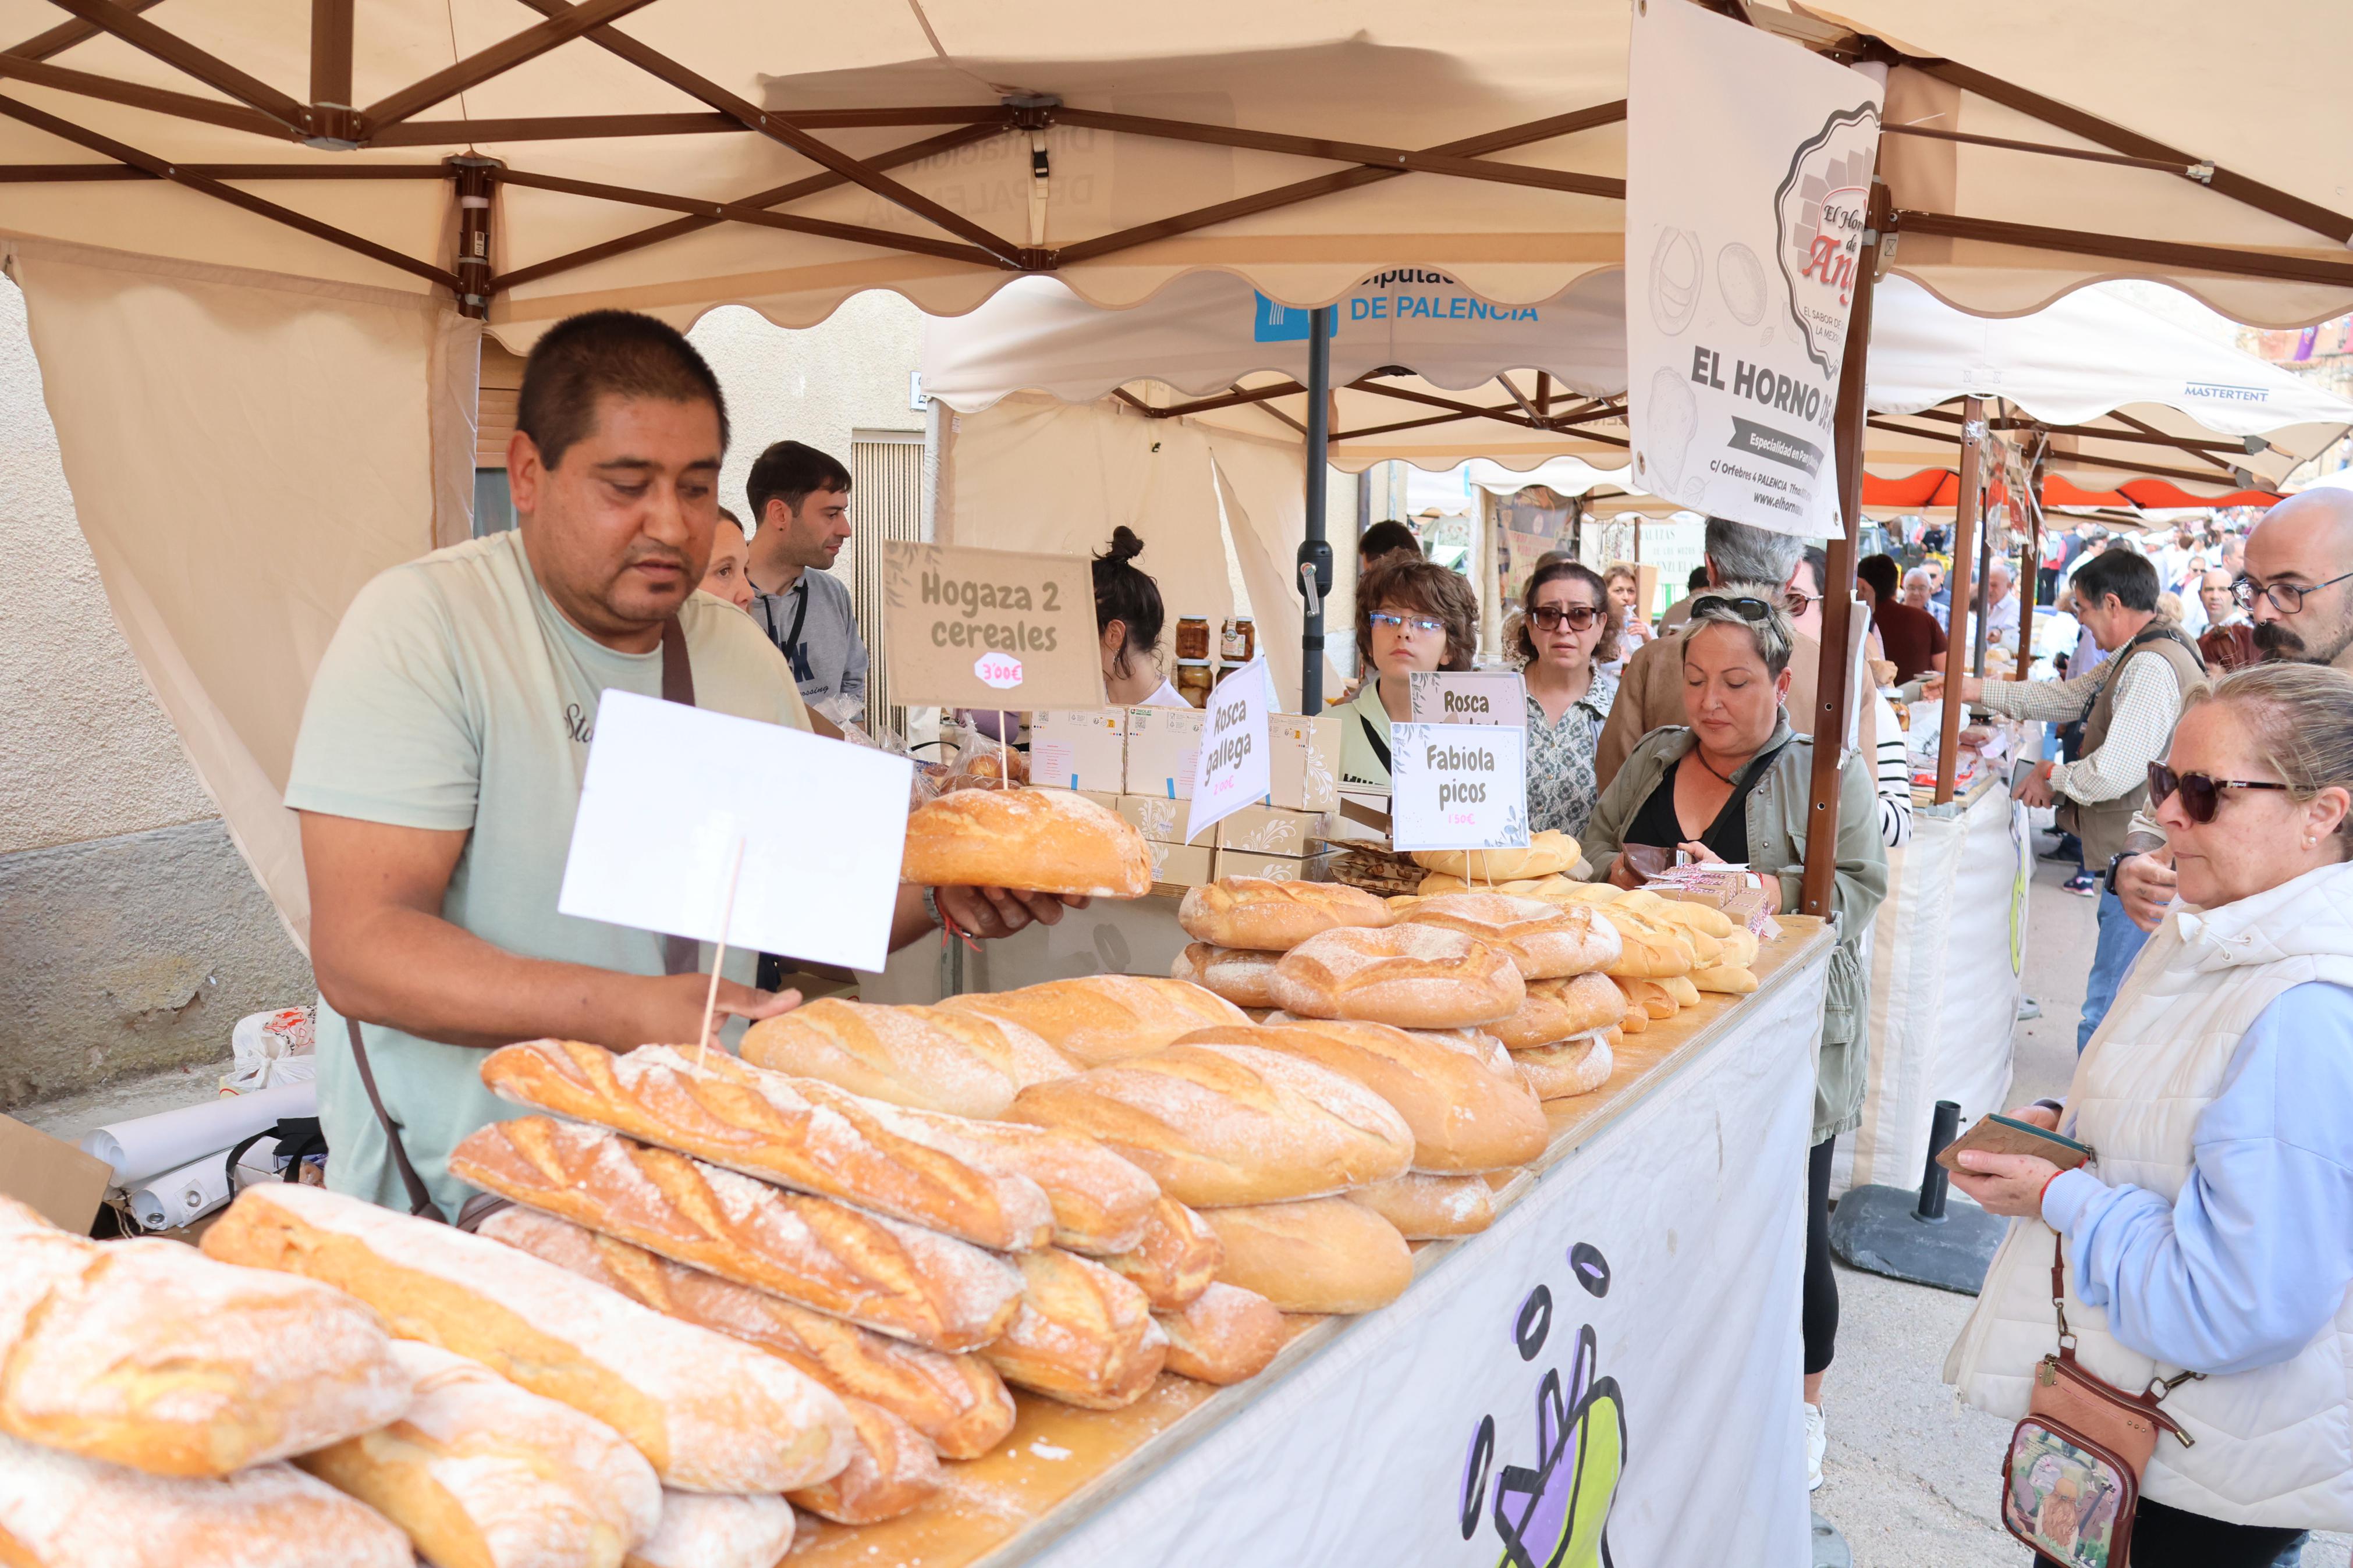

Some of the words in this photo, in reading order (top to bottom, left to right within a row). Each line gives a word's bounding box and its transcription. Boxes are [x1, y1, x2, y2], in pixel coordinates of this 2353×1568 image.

[1823, 205, 1841, 223] El
[1846, 234, 1857, 253] de
[1351, 297, 1388, 321] DE
[1804, 306, 1811, 317] EL
[1812, 310, 1833, 325] SABOR
[1815, 325, 1823, 337] LA
[1691, 345, 1726, 391] EL
[1733, 359, 1820, 422] HORNO
[2184, 386, 2269, 402] MASTERTENT
[1749, 432, 1794, 457] Especialidad
[1791, 449, 1800, 460] en
[1798, 450, 1808, 464] Pan
[1710, 459, 1722, 473] C/
[1722, 463, 1752, 481] Orfebres
[1752, 472, 1757, 482] 4
[1757, 473, 1787, 492] PALENCIA
[921, 571, 1032, 618] Hogaza
[1042, 581, 1061, 611] 2
[931, 620, 1057, 652] cereales
[1443, 691, 1489, 714] Rosca
[1214, 699, 1247, 737] Rosca
[1204, 733, 1251, 787] gallega
[1426, 744, 1495, 771] Fabiola
[1439, 778, 1486, 812] picos
